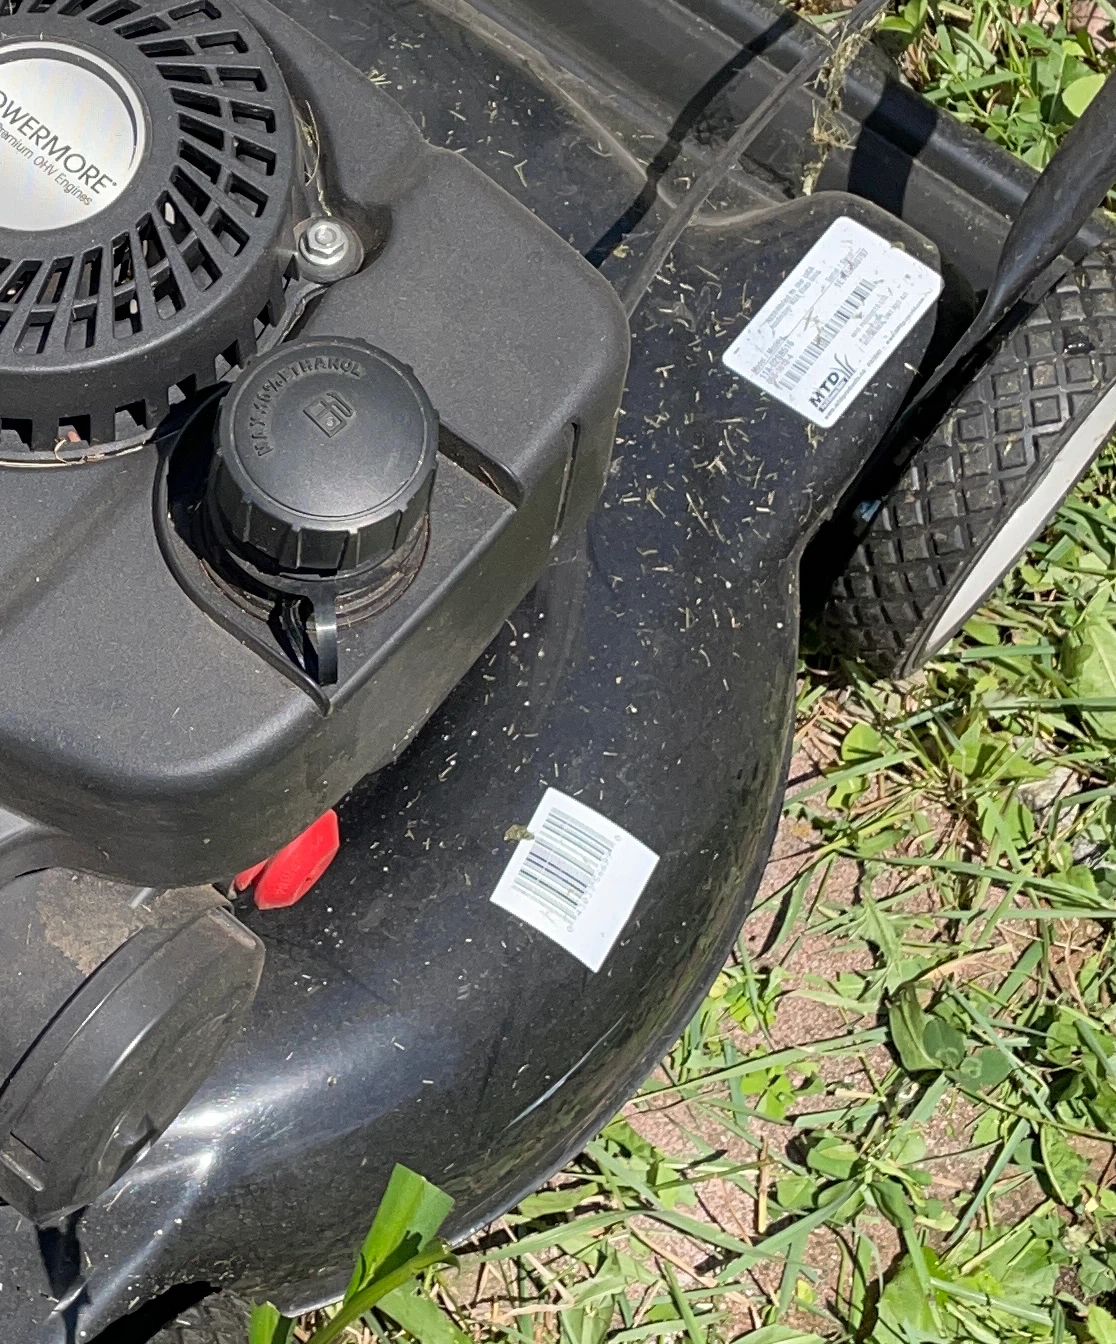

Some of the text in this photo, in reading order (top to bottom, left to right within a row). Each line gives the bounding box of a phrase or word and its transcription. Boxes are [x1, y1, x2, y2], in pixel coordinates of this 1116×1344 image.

[33, 154, 58, 177] OHV
[54, 172, 94, 206] Engines
[277, 356, 361, 384] ETHANOL
[809, 371, 840, 407] MTD
